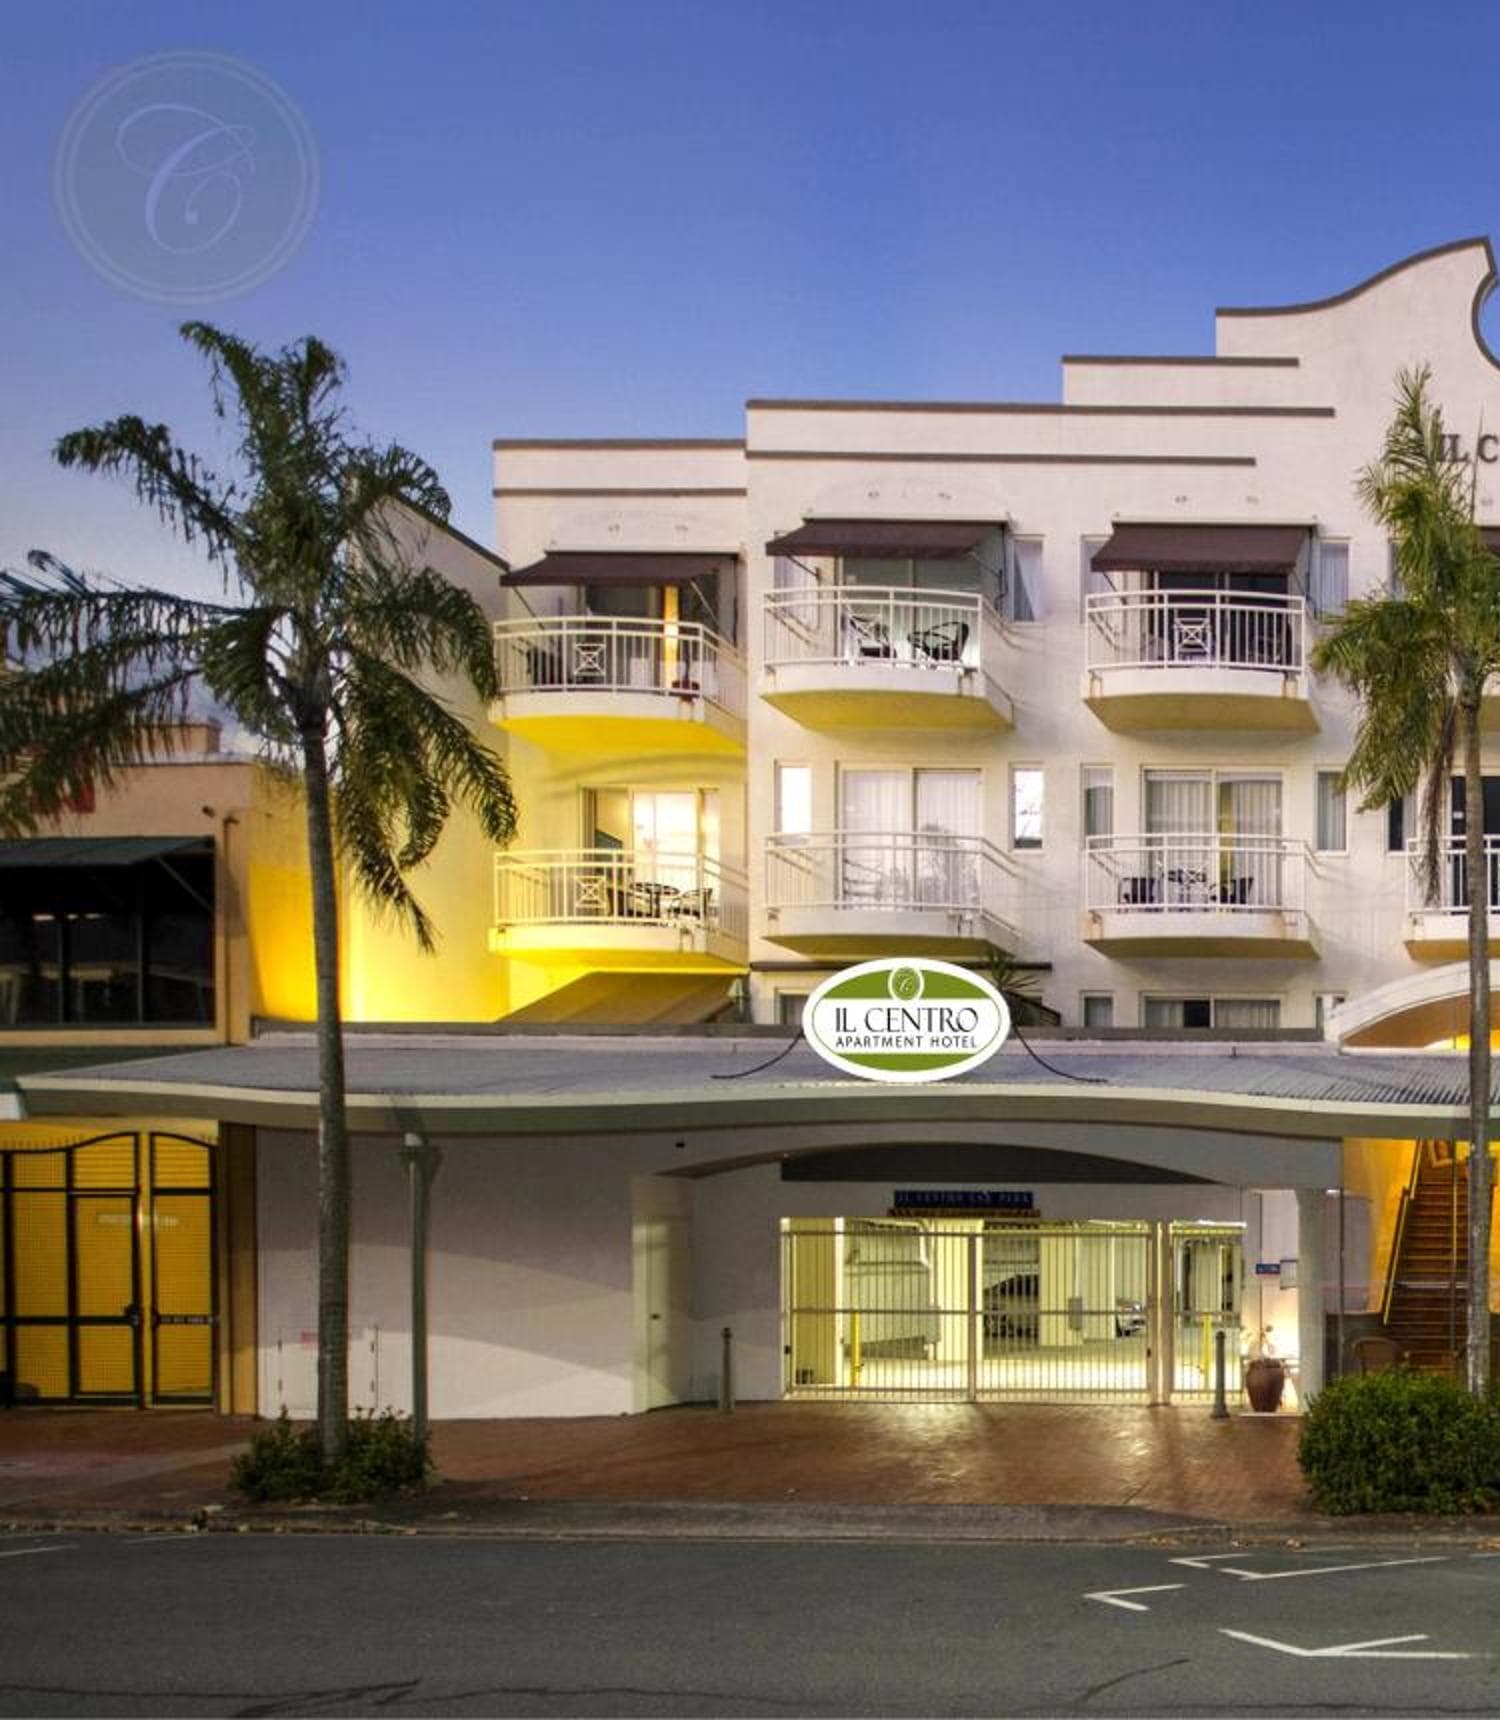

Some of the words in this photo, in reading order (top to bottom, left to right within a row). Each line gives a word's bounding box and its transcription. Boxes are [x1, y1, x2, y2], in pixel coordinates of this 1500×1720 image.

[835, 1007, 857, 1033] IL
[864, 1007, 979, 1033] CENTRO
[836, 1035, 922, 1049] APARTMENT
[930, 1035, 977, 1049] HOTEL
